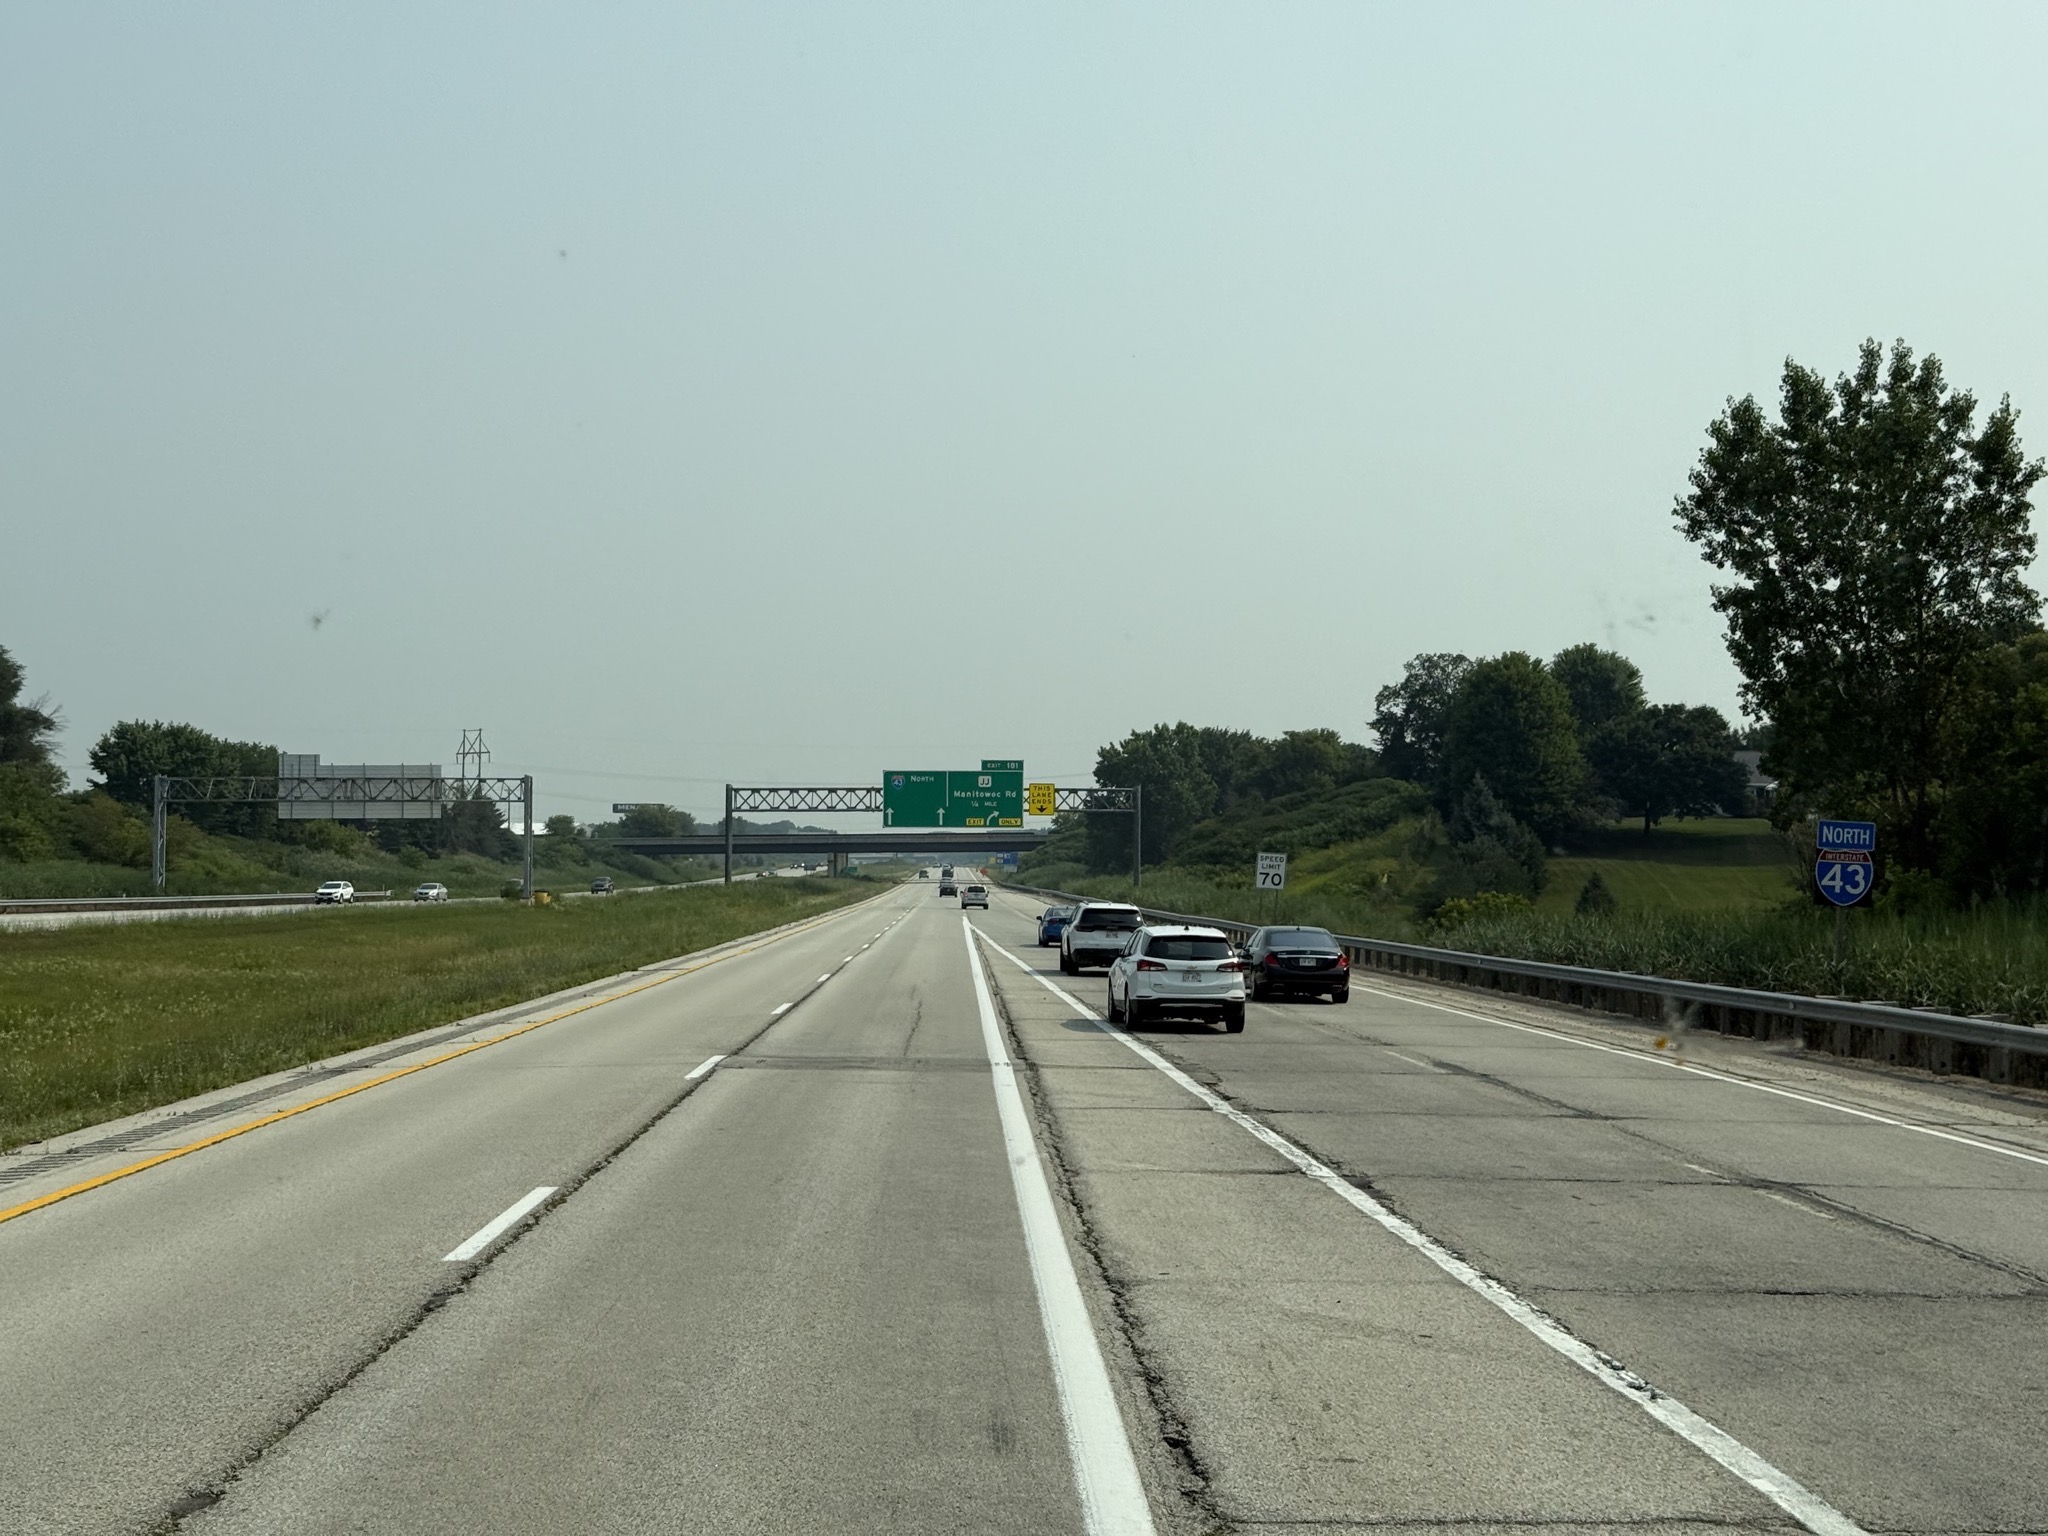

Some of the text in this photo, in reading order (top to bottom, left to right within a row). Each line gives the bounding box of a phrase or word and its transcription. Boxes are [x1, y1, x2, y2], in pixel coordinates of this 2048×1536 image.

[980, 778, 990, 786] JJ
[1822, 826, 1870, 845] NORTH
[1826, 852, 1864, 861] INTERSTATE
[1259, 872, 1282, 886] 70
[1820, 864, 1865, 894] 43
